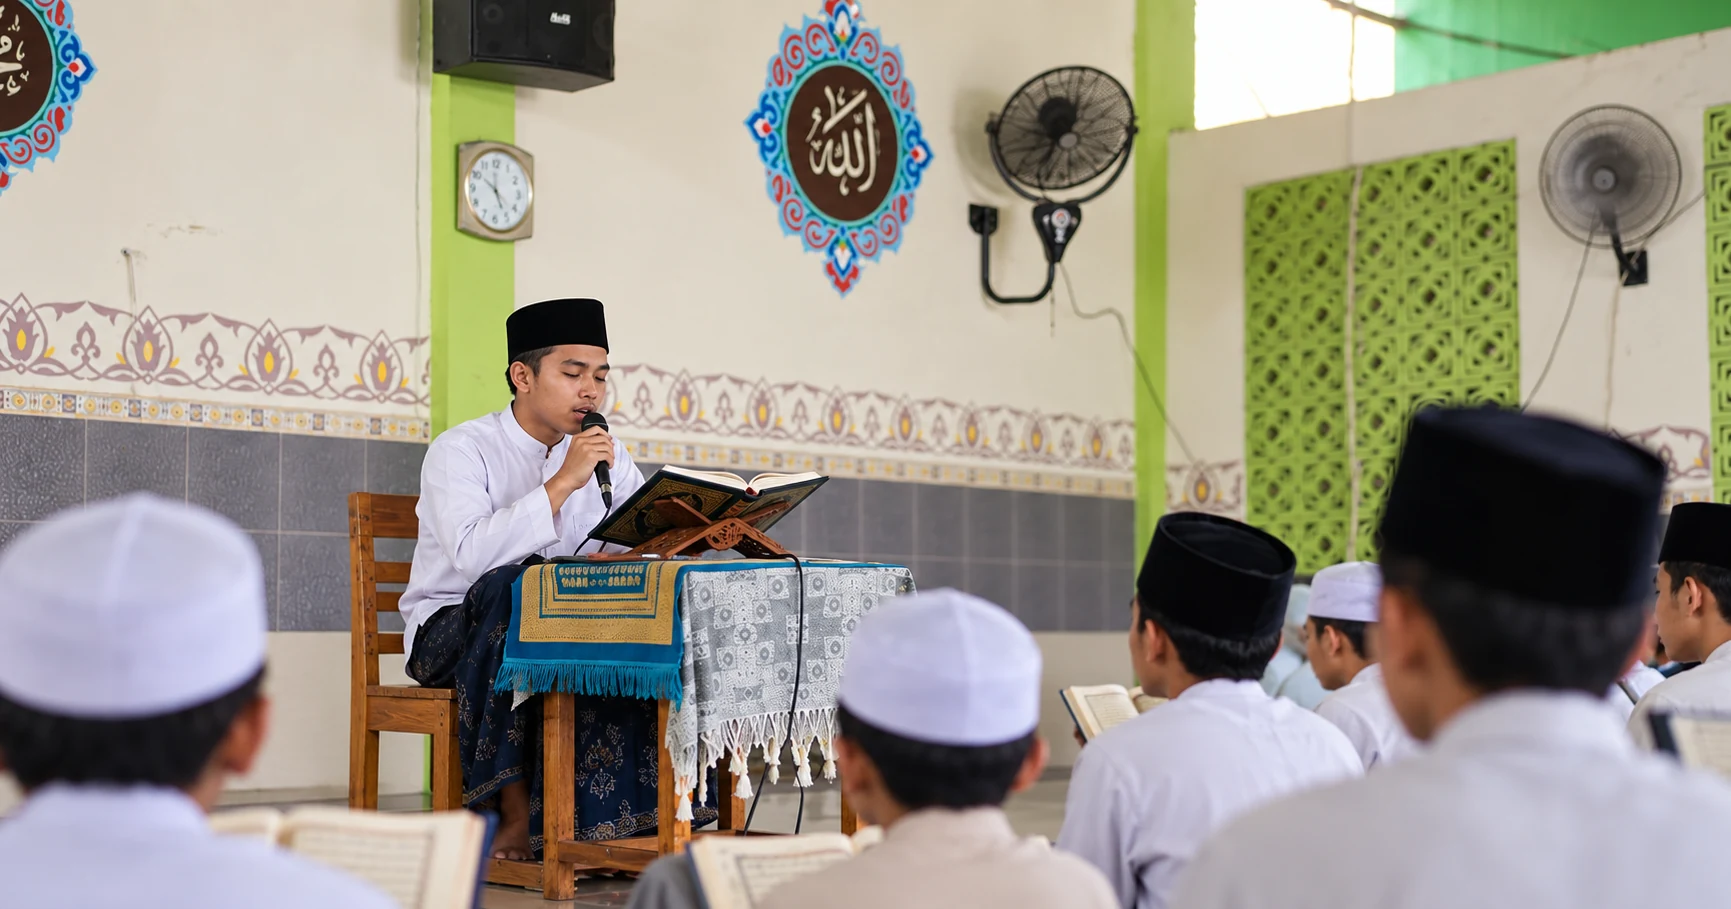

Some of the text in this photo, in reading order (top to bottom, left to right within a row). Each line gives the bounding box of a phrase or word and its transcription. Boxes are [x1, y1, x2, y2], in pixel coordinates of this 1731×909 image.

[492, 159, 501, 169] 12
[512, 175, 519, 186] 2
[470, 183, 477, 193] 9
[516, 189, 522, 201] 3
[482, 208, 488, 219] 7
[491, 214, 499, 224] 6
